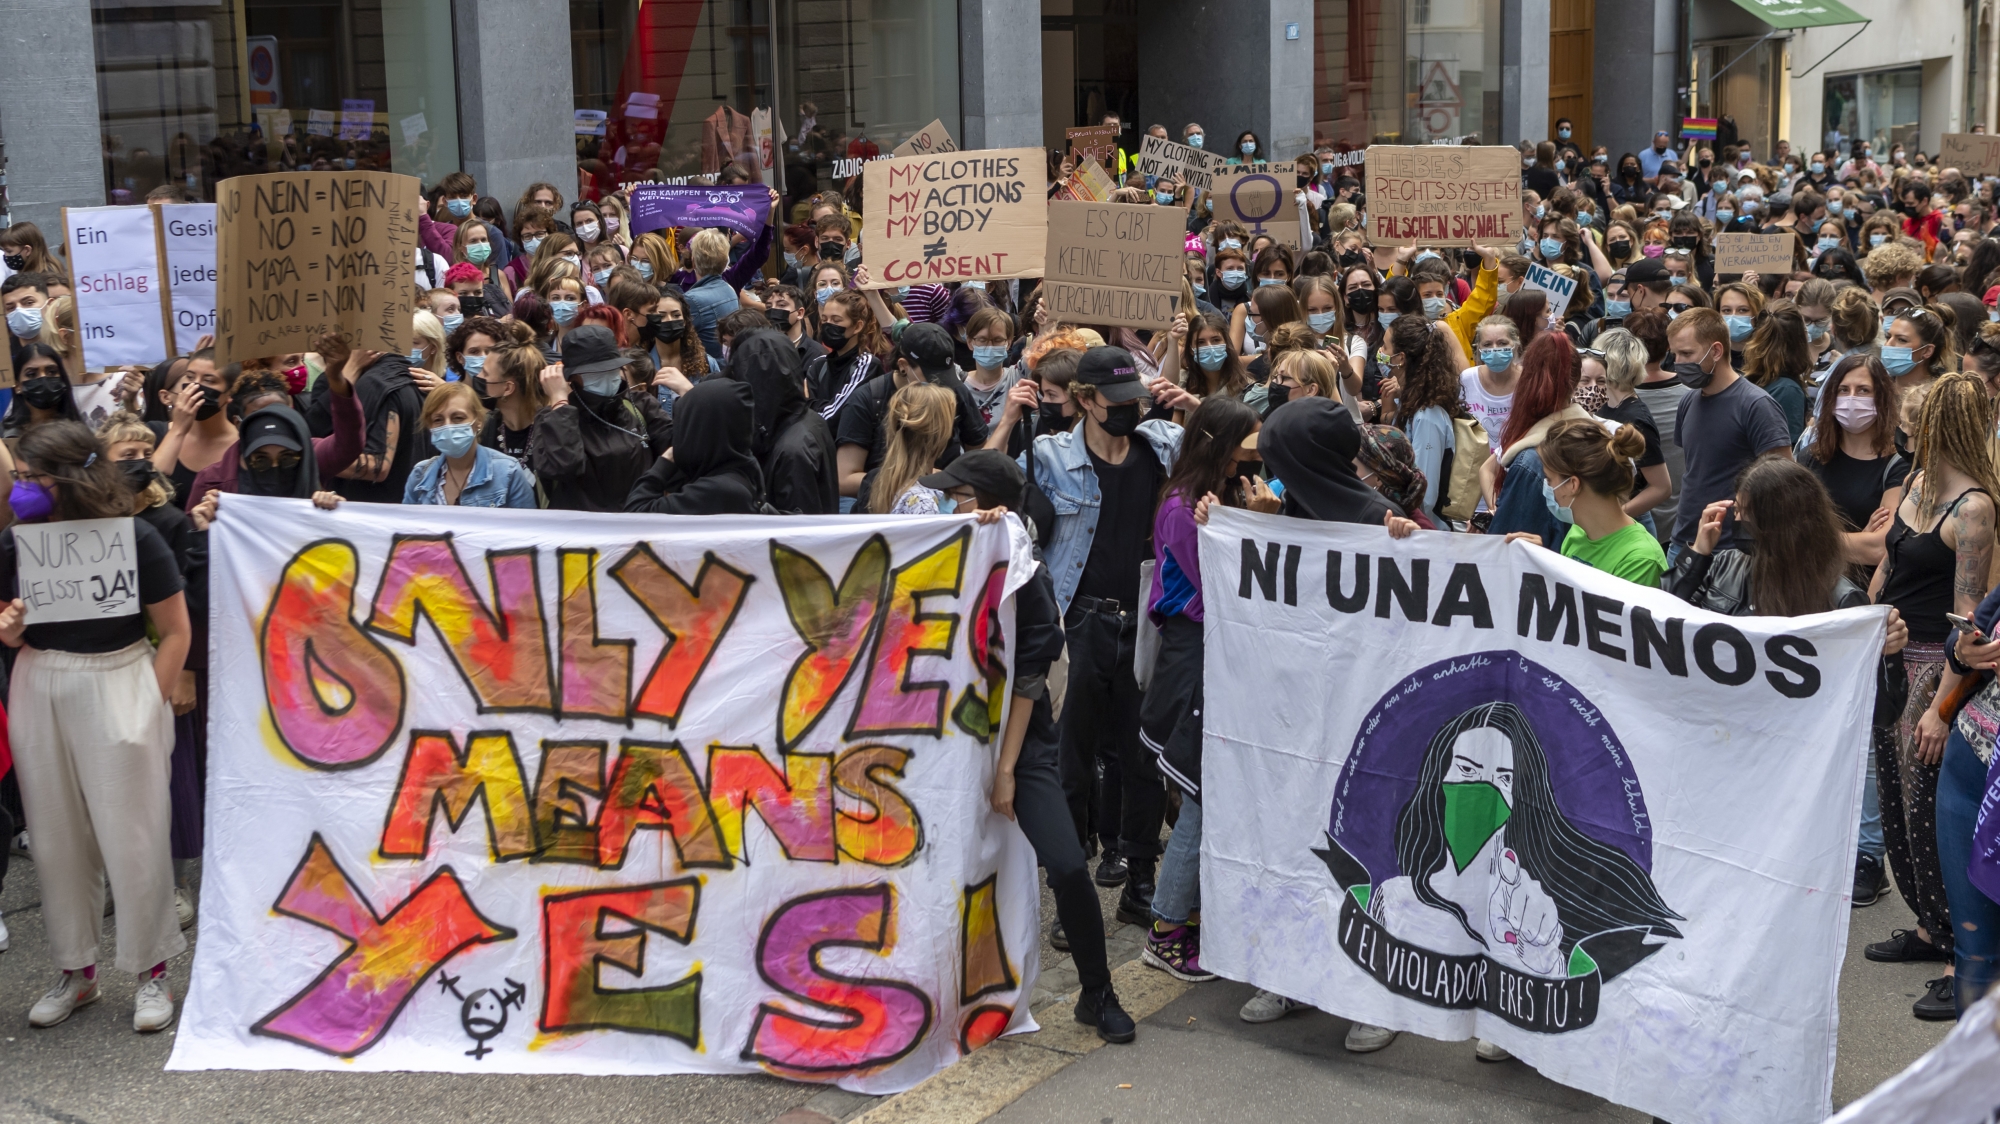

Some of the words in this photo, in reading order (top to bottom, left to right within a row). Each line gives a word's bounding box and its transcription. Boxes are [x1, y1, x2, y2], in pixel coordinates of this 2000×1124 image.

[1289, 25, 1297, 36] 10
[1140, 156, 1158, 176] NOT
[1161, 164, 1179, 179] AN
[1145, 135, 1161, 154] MY
[1163, 140, 1209, 169] CLOTHING
[1374, 153, 1464, 179] LIEBES
[832, 158, 863, 180] ZADIG
[889, 161, 925, 188] MY
[923, 157, 1019, 182] CLOTHES
[1213, 167, 1228, 176] 11
[1273, 163, 1294, 173] Sind
[254, 179, 310, 218] NEIN
[330, 178, 387, 212] NEIN
[888, 188, 921, 215] MY
[923, 180, 1026, 209] ACTIONS
[1375, 177, 1519, 201] RECHTSSYSTEM
[886, 212, 922, 239] MY
[923, 207, 993, 236] BODY
[1375, 201, 1412, 214] BITTE
[1418, 202, 1449, 213] SENDE
[1455, 202, 1487, 213] KEINE
[76, 226, 108, 245] Ein
[258, 217, 296, 250] NO
[331, 216, 367, 249] NO
[1085, 209, 1109, 238] ES
[1115, 211, 1156, 242] GIBT
[1058, 246, 1109, 278] KEINE
[1718, 244, 1769, 254] MITSCHULD
[80, 272, 149, 293] Schlag
[247, 255, 301, 290] MAYA
[326, 250, 380, 282] MAYA
[382, 250, 399, 290] SIND
[883, 252, 1009, 282] CONSENT
[1525, 264, 1574, 297] NEIN
[249, 289, 299, 323] NON
[322, 283, 366, 318] NON
[84, 322, 115, 340] ins
[277, 325, 302, 337] ARE
[304, 322, 329, 335] WE
[16, 530, 84, 568] NUR
[89, 529, 127, 563] JA
[21, 579, 85, 611] HEISST
[90, 569, 137, 602] JA!
[1238, 538, 1302, 607] NI
[1325, 550, 1495, 629] UNA
[1517, 572, 1822, 699] MENOS
[260, 532, 756, 772] ONLY
[1519, 657, 1529, 673] Es
[1541, 674, 1562, 692] ist
[1569, 697, 1601, 727] nicht
[1601, 734, 1624, 769] meine
[1333, 797, 1345, 837] egal
[1346, 757, 1358, 777] ich
[1355, 736, 1365, 757] war
[1366, 711, 1381, 735] oder
[1384, 693, 1400, 710] was
[1403, 676, 1423, 695] ich
[1432, 655, 1492, 681] anhatte
[379, 729, 925, 870] MEANS
[1357, 923, 1378, 973] EL
[1499, 969, 1535, 1023] ERES
[1544, 980, 1569, 1028] TÚ
